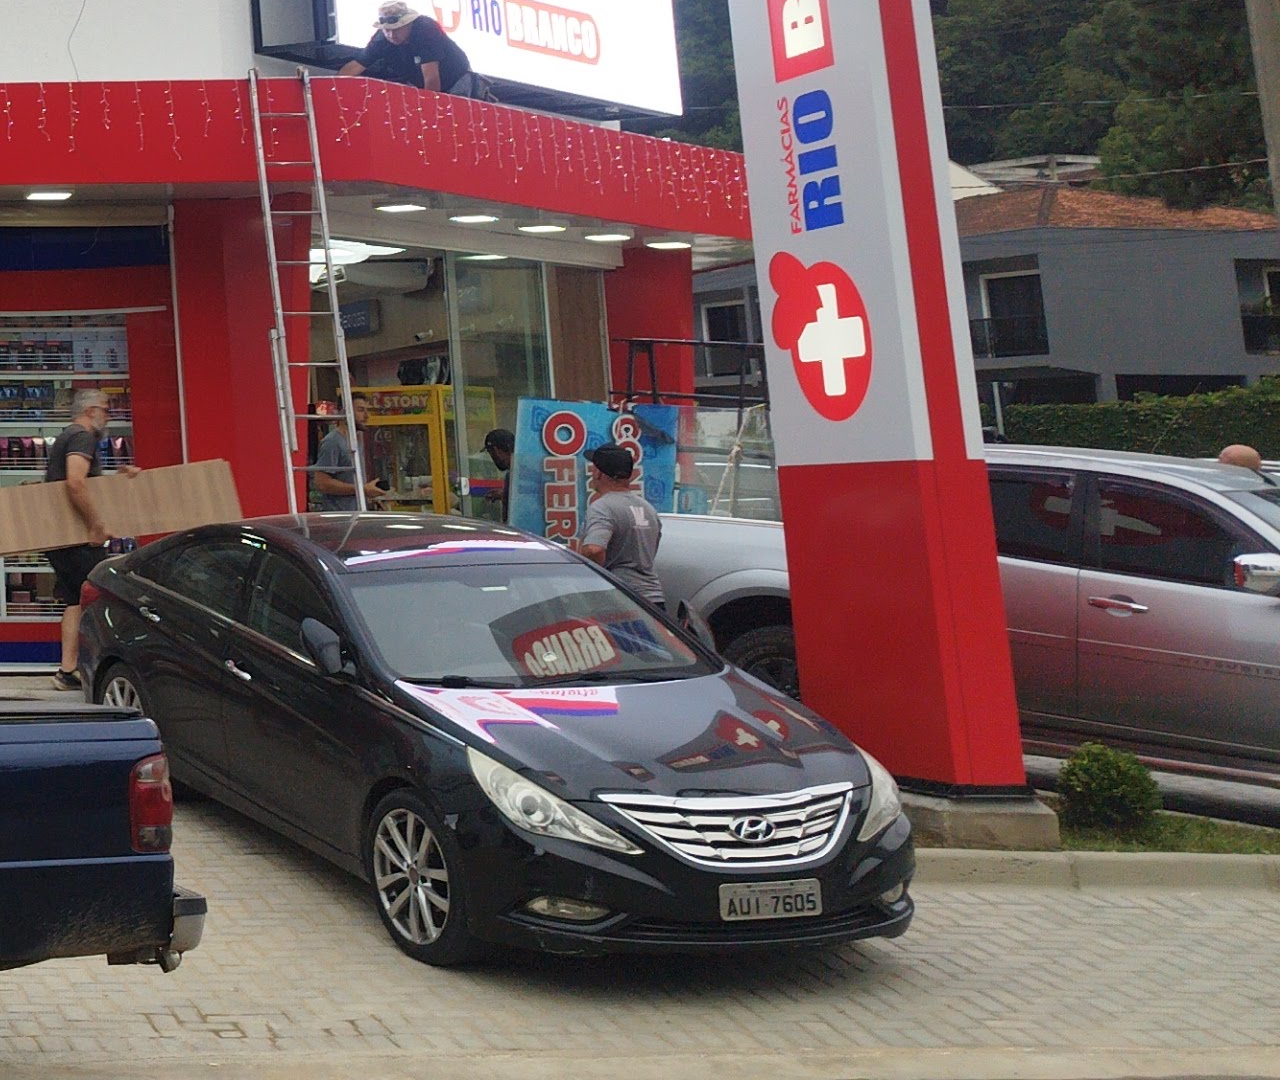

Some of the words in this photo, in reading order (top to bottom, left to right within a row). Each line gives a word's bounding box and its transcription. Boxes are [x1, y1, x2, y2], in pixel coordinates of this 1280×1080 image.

[505, 1, 599, 60] BRANCO
[777, 96, 803, 235] FARMÁCIAS
[792, 89, 845, 232] RIO
